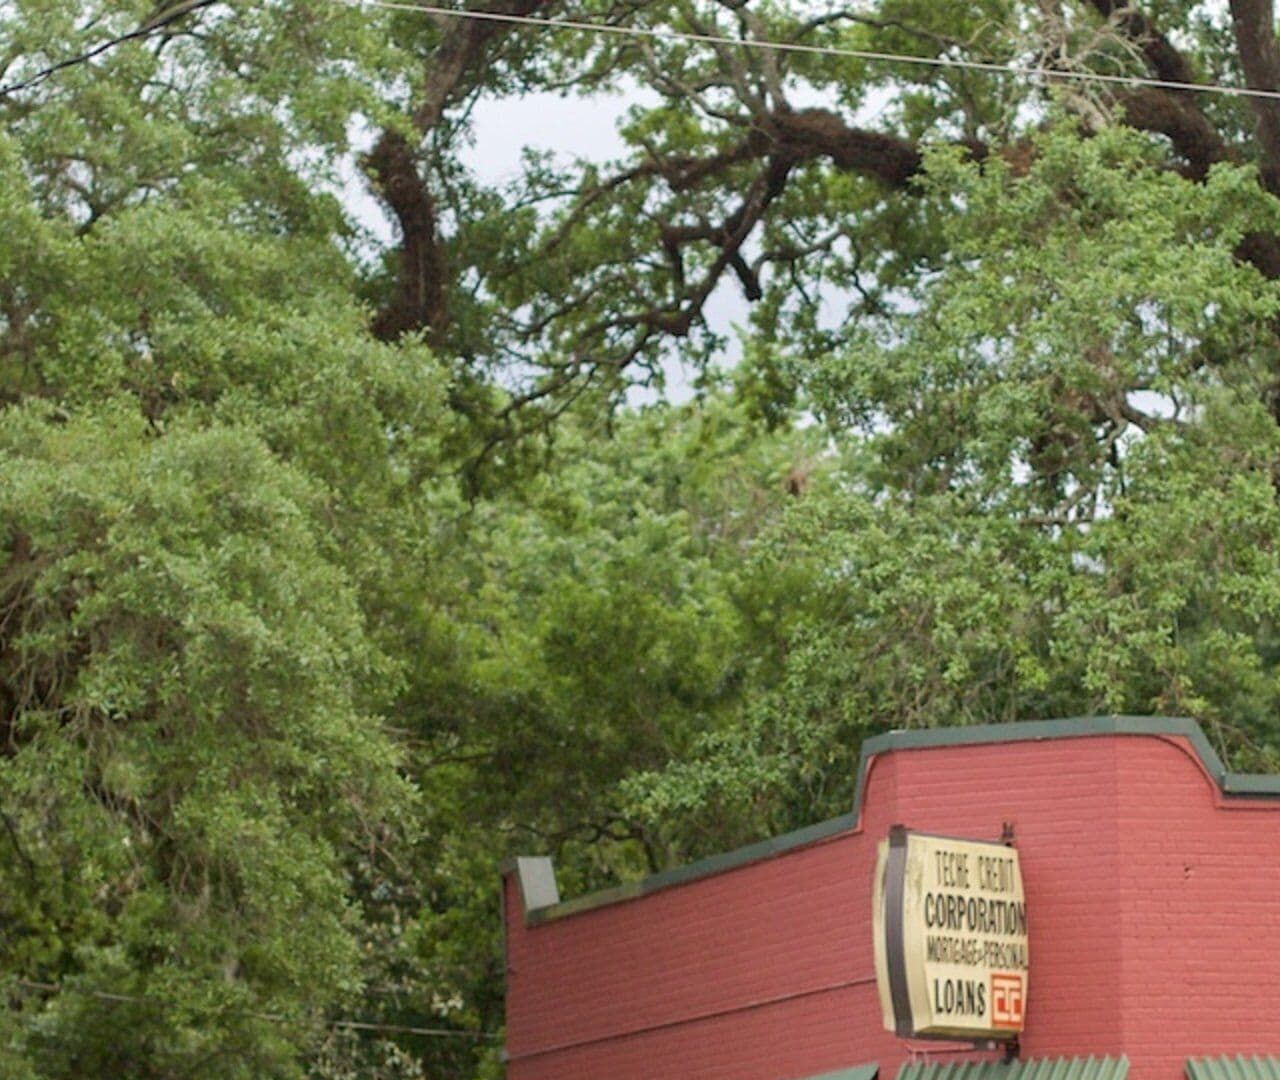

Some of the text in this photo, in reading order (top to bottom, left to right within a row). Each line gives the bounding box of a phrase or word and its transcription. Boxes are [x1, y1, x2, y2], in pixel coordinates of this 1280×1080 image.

[935, 850, 1014, 893] TECHE CREDIT
[925, 891, 1028, 936] CORPORATION
[934, 977, 986, 1017] LOANS
